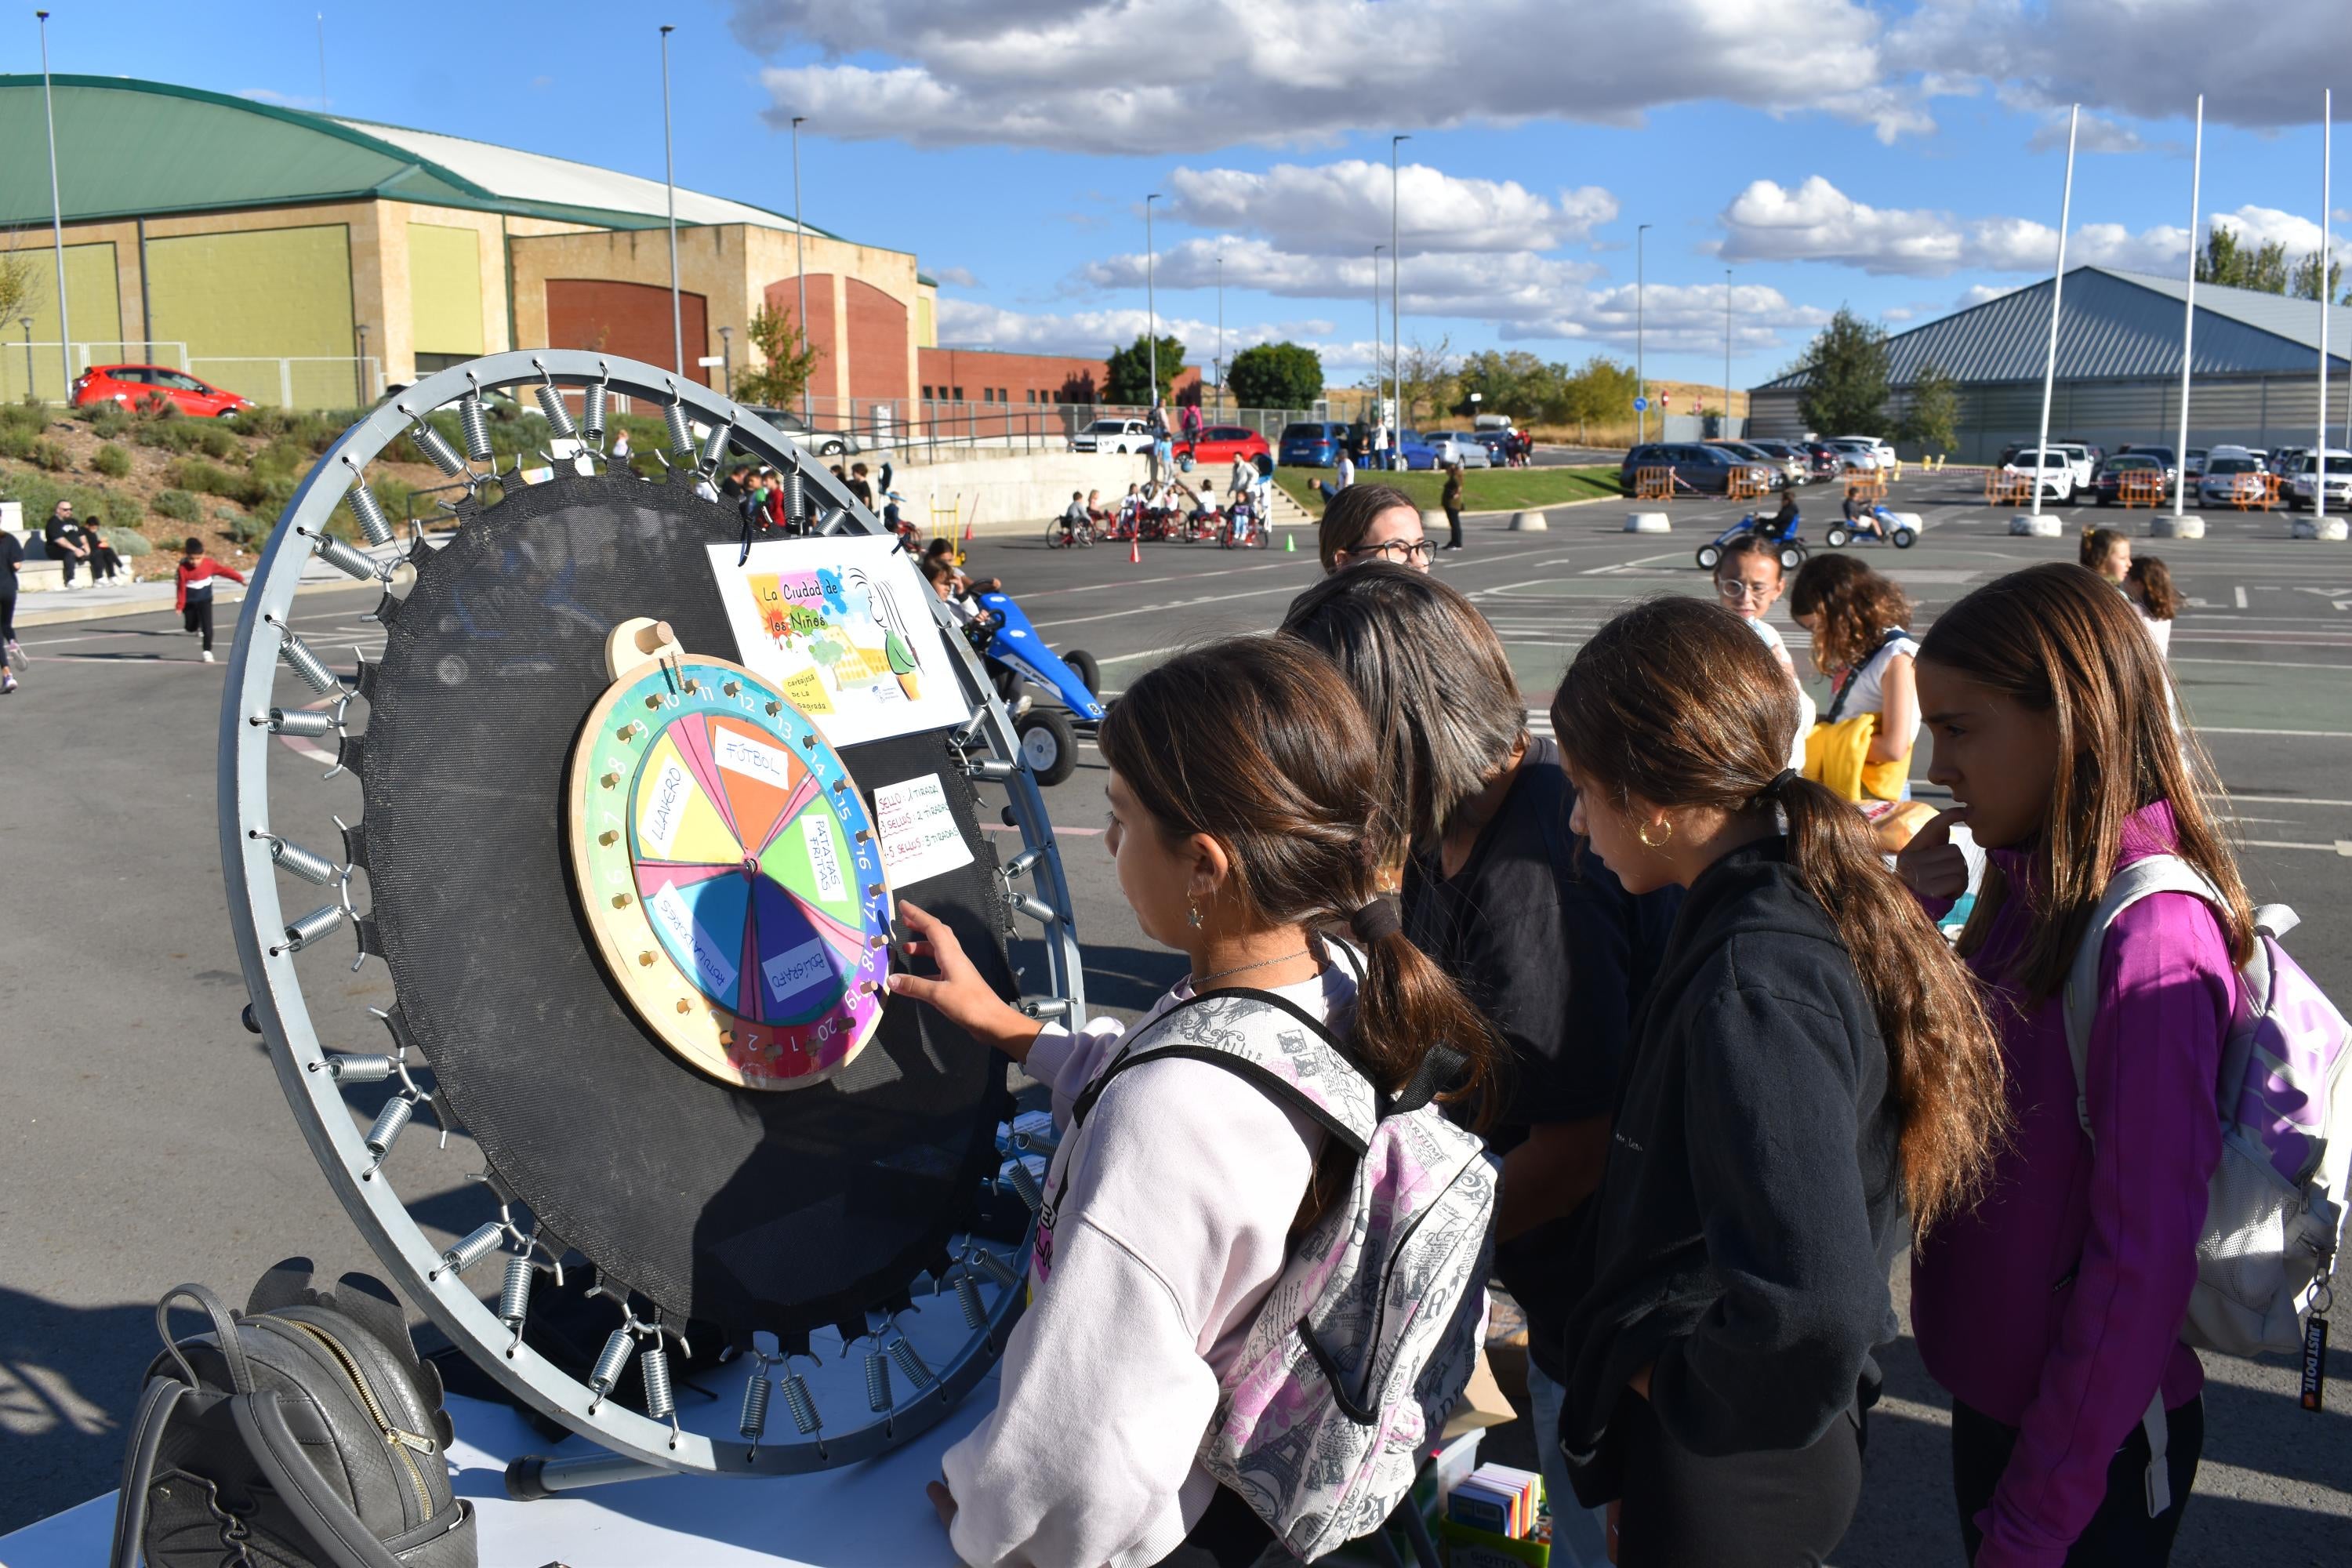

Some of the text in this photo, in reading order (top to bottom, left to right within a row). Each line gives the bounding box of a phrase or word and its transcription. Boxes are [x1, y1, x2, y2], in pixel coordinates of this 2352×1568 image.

[764, 579, 838, 601] La Ciudad de
[770, 613, 826, 632] los Niños
[699, 686, 714, 702] 11
[738, 694, 756, 713] 12
[1090, 704, 1099, 714] 8
[632, 718, 649, 739] 9
[777, 717, 793, 739] 13
[608, 757, 626, 775] 8
[726, 742, 781, 775] FÚTBOL
[811, 751, 826, 777] 14
[913, 785, 938, 798] TIRADA
[652, 768, 681, 840] LLAVERO
[837, 797, 852, 821] 15
[917, 811, 924, 821] 2
[924, 835, 931, 847] 3
[815, 820, 840, 885] PATATAS
[855, 848, 872, 869] 16
[863, 901, 877, 923] 17
[660, 900, 725, 986] ROTULADORES
[862, 949, 875, 972] 18
[844, 989, 862, 1011] 19
[818, 1017, 837, 1041] 20
[748, 1034, 758, 1051] 2
[790, 1036, 800, 1052] 1
[2307, 1323, 2321, 1357] JUST
[2306, 1359, 2318, 1377] DO
[1470, 1551, 1518, 1568] GIOTTO
